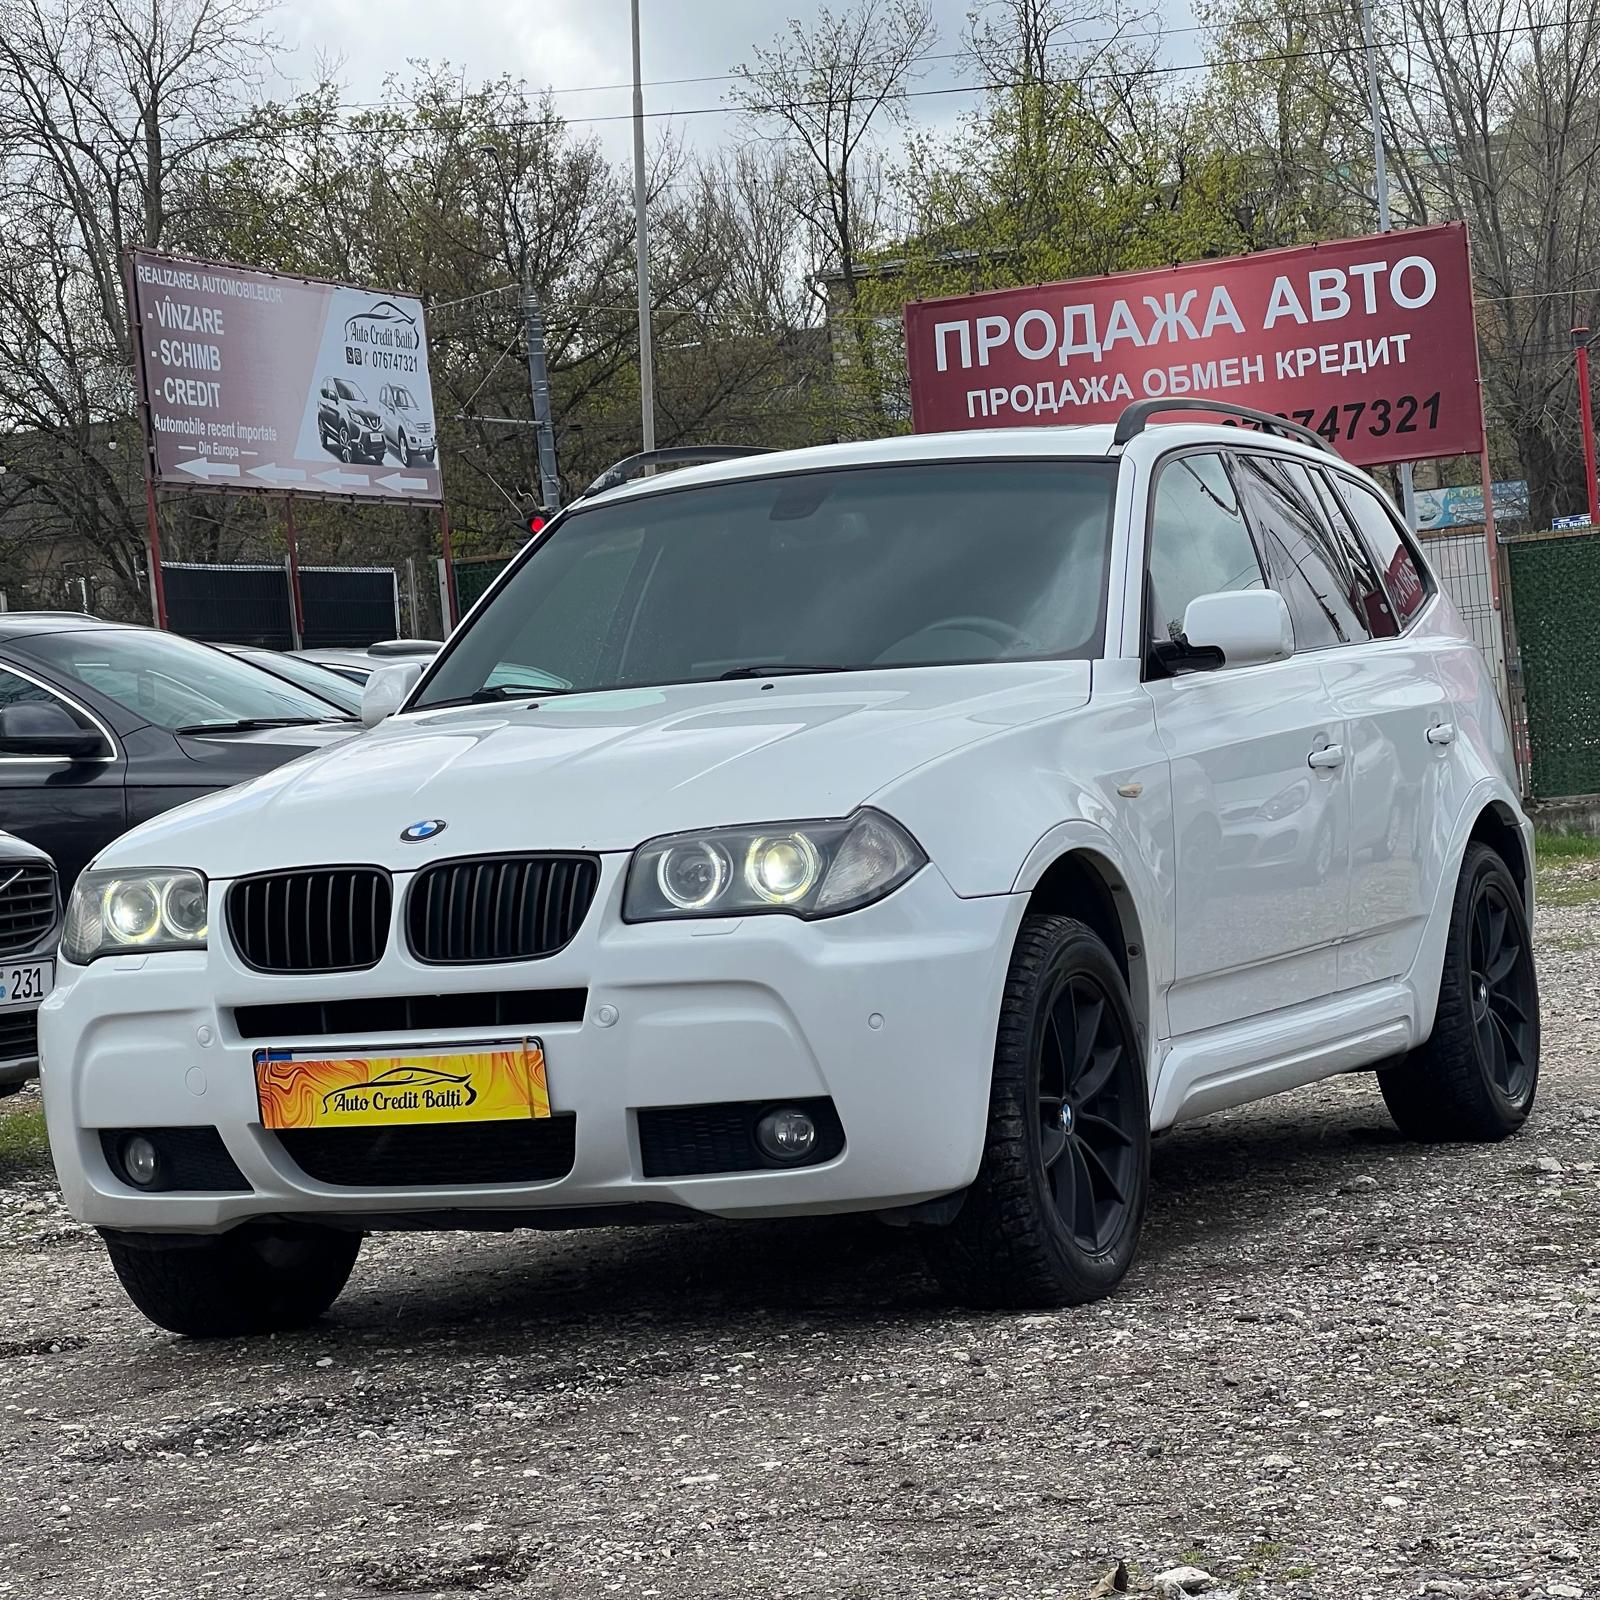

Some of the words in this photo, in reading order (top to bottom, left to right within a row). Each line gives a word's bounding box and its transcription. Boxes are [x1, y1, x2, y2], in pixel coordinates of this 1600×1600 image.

[138, 265, 200, 291] REALIZAREA
[202, 276, 283, 303] AUTOMOBILELOR
[155, 295, 225, 335] VÎNZARE
[934, 285, 1247, 373] ПРОДАЖА
[1263, 255, 1437, 330] АВТО
[350, 321, 369, 343] Auto
[370, 324, 393, 347] Credit
[160, 339, 221, 371] SCHIMB
[372, 350, 418, 373] 076747321
[967, 373, 1134, 419] ПРОДАЖА
[1143, 354, 1265, 398] ОБМЕН
[1276, 334, 1412, 381] КРЕДИТ
[164, 377, 221, 408] CREDIT
[154, 413, 206, 436] Automobile
[207, 422, 235, 439] recent
[237, 421, 277, 444] importate
[198, 441, 212, 455] Din
[213, 442, 239, 459] Europa
[11, 967, 43, 1000] 231
[334, 1092, 370, 1112] Auto
[372, 1091, 420, 1111] Credit
[422, 1089, 463, 1109] Bălți
